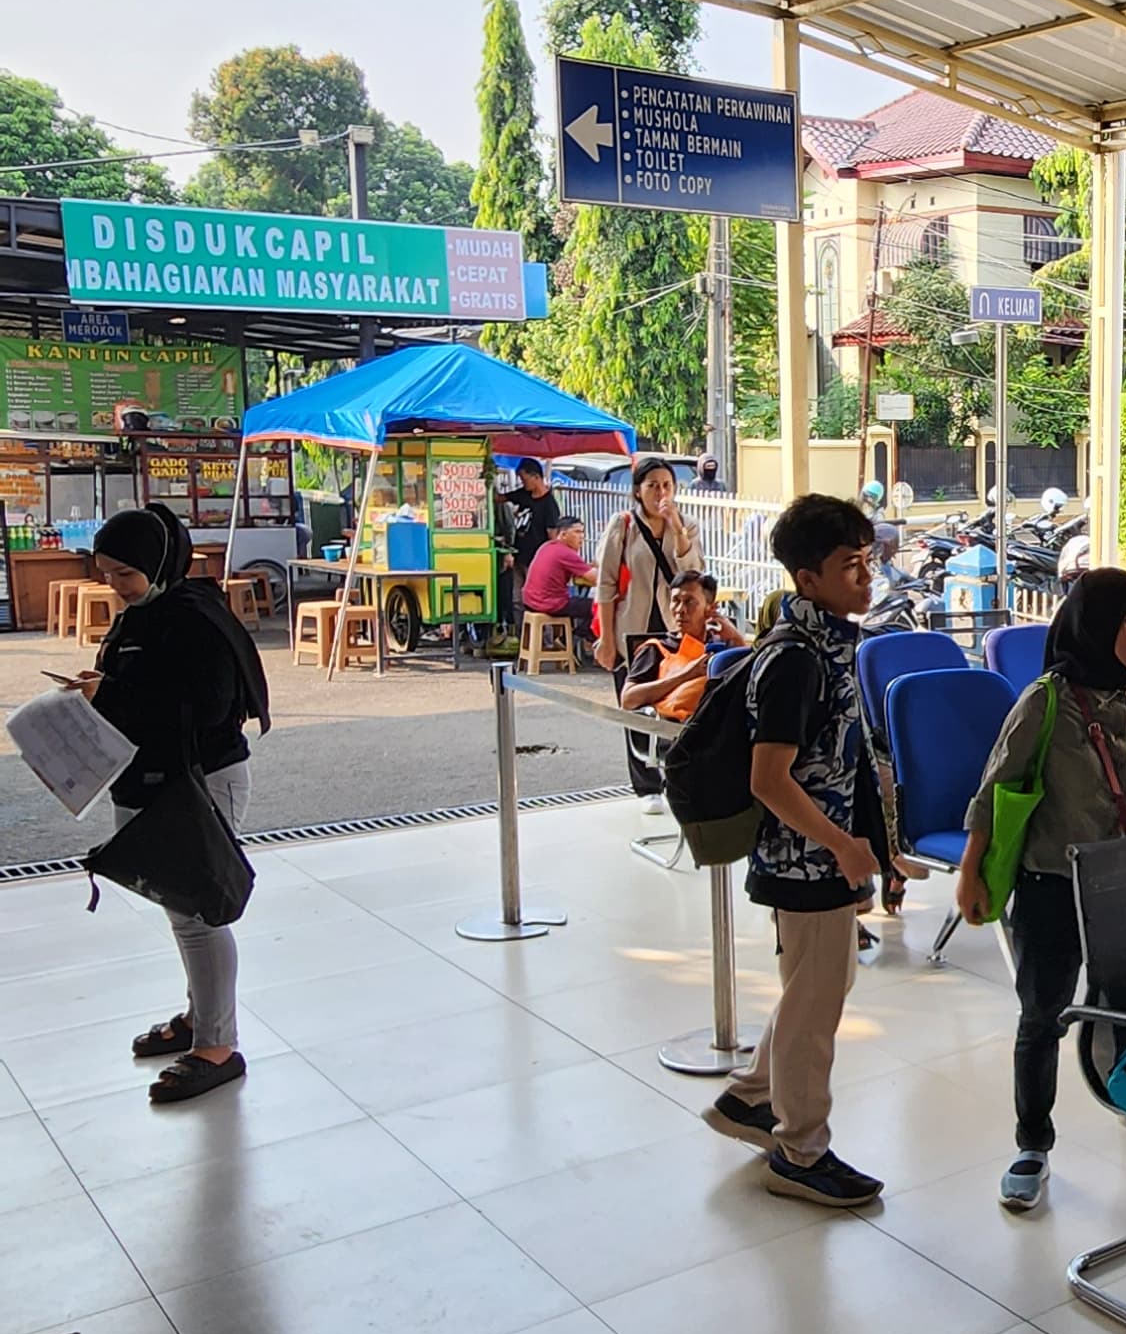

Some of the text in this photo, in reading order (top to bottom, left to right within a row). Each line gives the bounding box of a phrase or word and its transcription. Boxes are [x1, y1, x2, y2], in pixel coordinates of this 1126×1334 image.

[633, 85, 792, 125] PENCATATAN PERKAWINAN
[633, 107, 699, 133] MUSHOLA
[635, 128, 742, 159] TAMAN BERMAIN
[635, 148, 685, 172] TOILET
[636, 170, 712, 196] FOTO COPY
[92, 214, 375, 265] DISDUKCAPIL
[455, 238, 514, 259] MUDAH
[457, 266, 508, 284] CEPAT
[276, 269, 440, 305] MASYARAKAT
[459, 291, 518, 310] GRATIS
[997, 296, 1035, 316] KELUAR
[80, 313, 110, 325] AREA
[68, 324, 123, 337] MEROKOK
[26, 344, 215, 365] KANTIN CAPIL
[150, 457, 189, 468] GADO
[443, 463, 477, 477] SOTO
[150, 467, 189, 478] GADO
[434, 479, 484, 495] KUNING
[444, 497, 478, 512] SOTO
[451, 513, 473, 527] MIE
